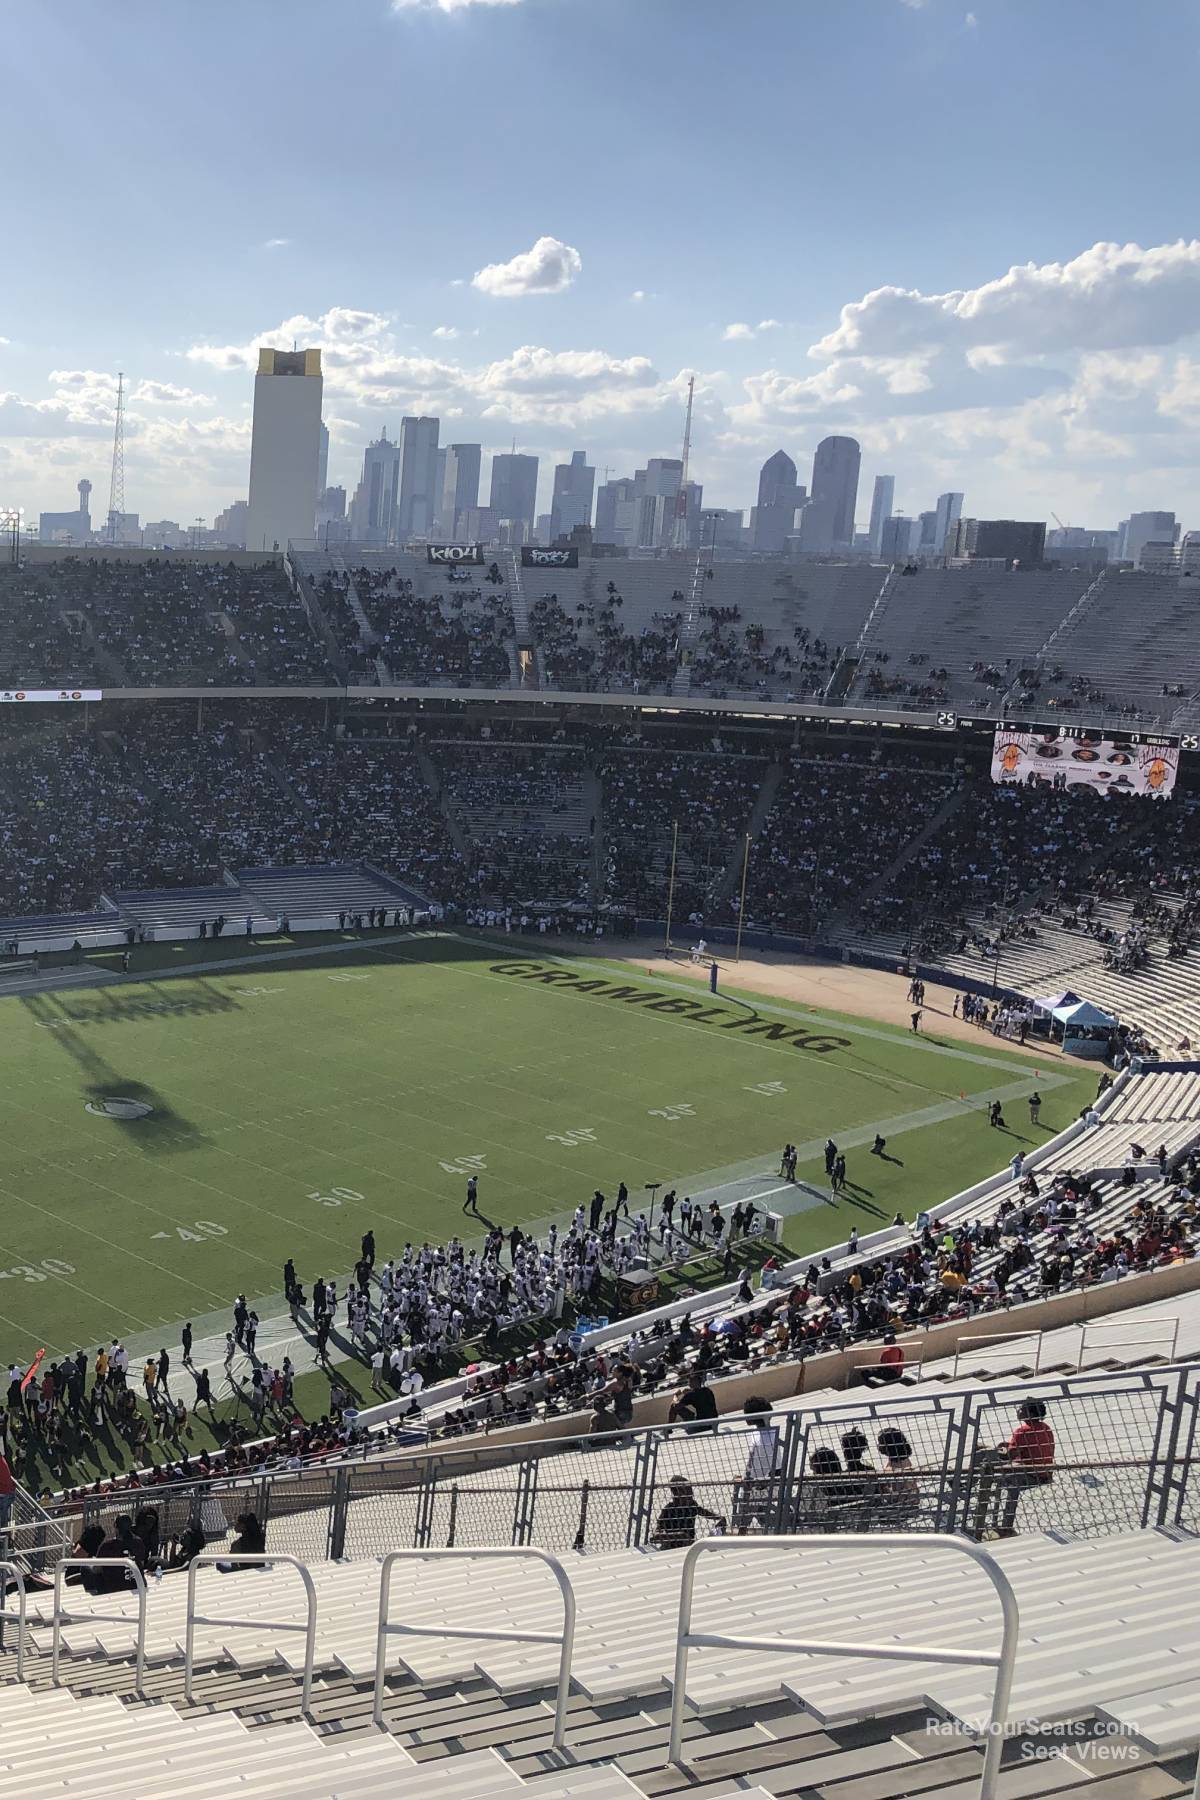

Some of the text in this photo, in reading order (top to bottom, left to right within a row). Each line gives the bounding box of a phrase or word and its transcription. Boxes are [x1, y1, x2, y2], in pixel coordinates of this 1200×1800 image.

[938, 712, 954, 725] 25
[1059, 726, 1078, 737] 8:11
[1181, 734, 1198, 749] 25
[489, 963, 852, 1054] GRAMBLING
[306, 1186, 366, 1207] 50
[176, 1220, 230, 1243] 40
[8, 1258, 77, 1284] 30
